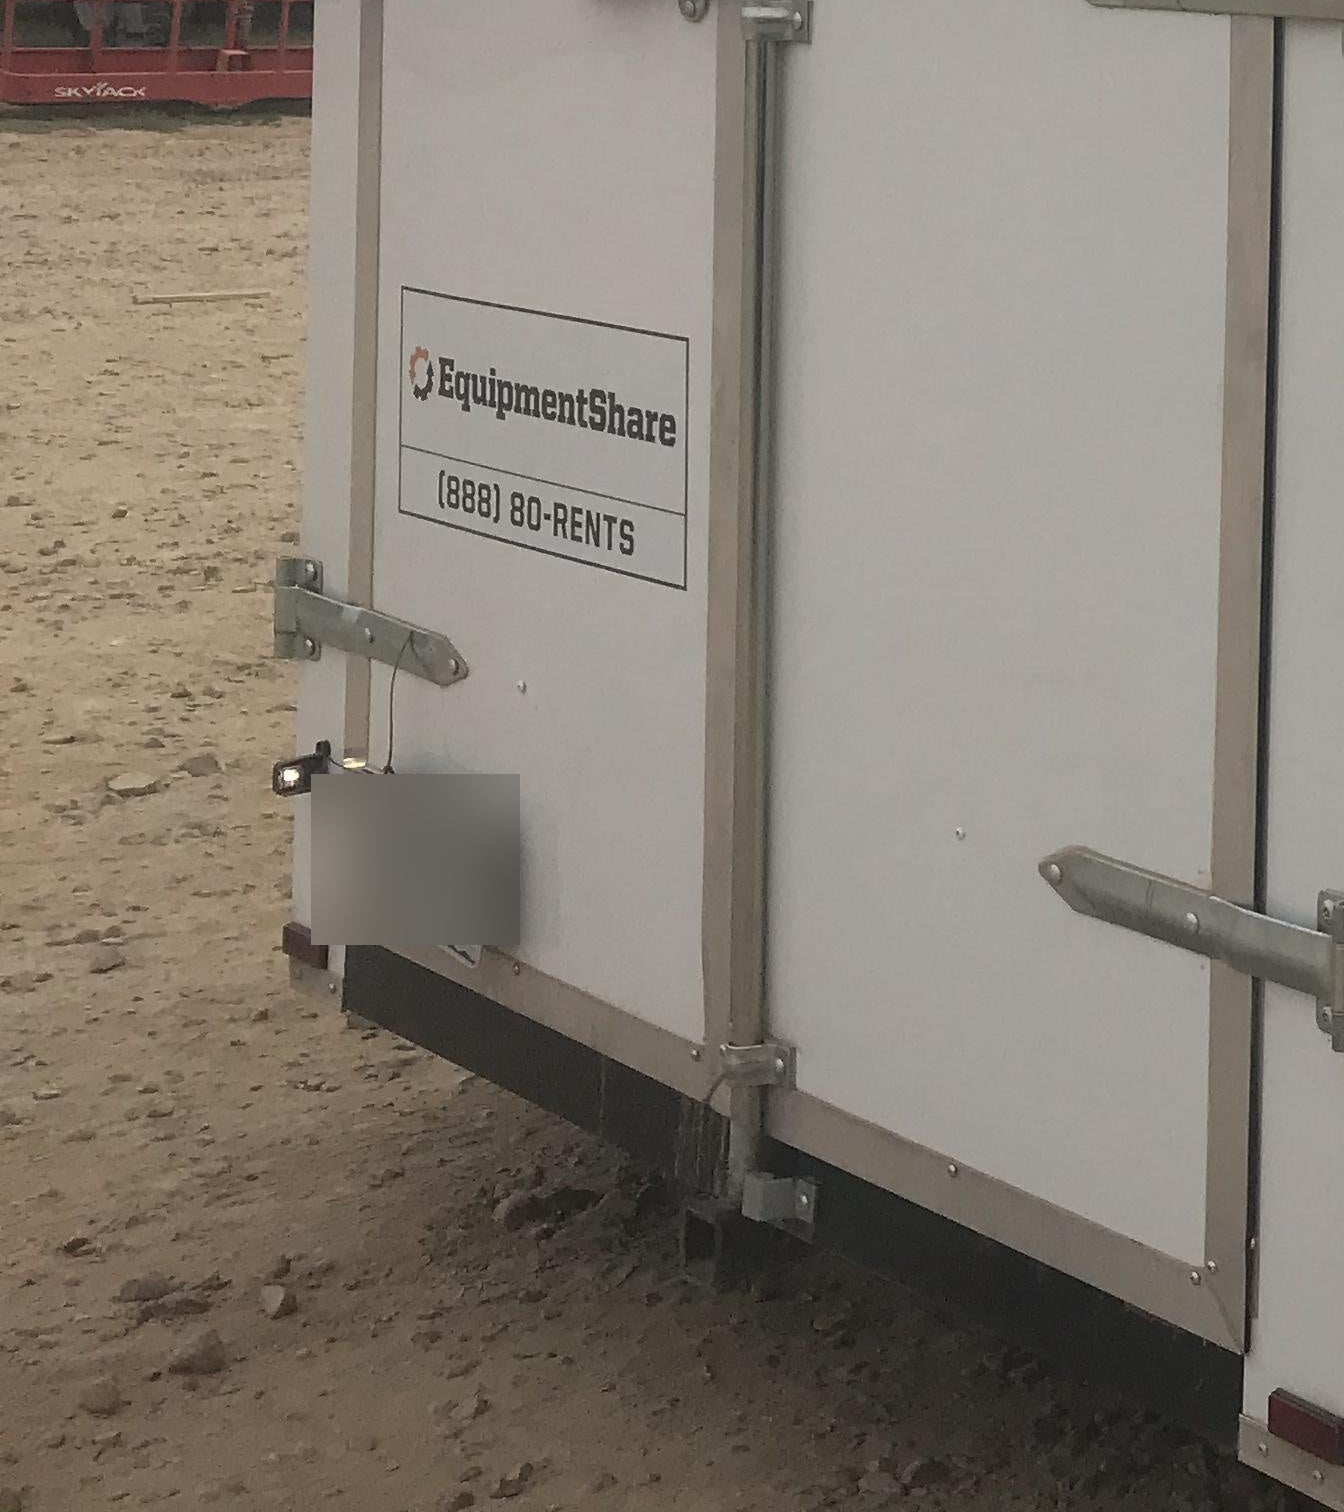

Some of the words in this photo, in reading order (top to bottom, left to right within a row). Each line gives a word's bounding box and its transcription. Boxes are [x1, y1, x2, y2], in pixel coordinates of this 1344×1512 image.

[438, 356, 677, 447] EquipmentShare
[438, 469, 500, 523] (888)
[510, 491, 635, 556] 80-RENTS
